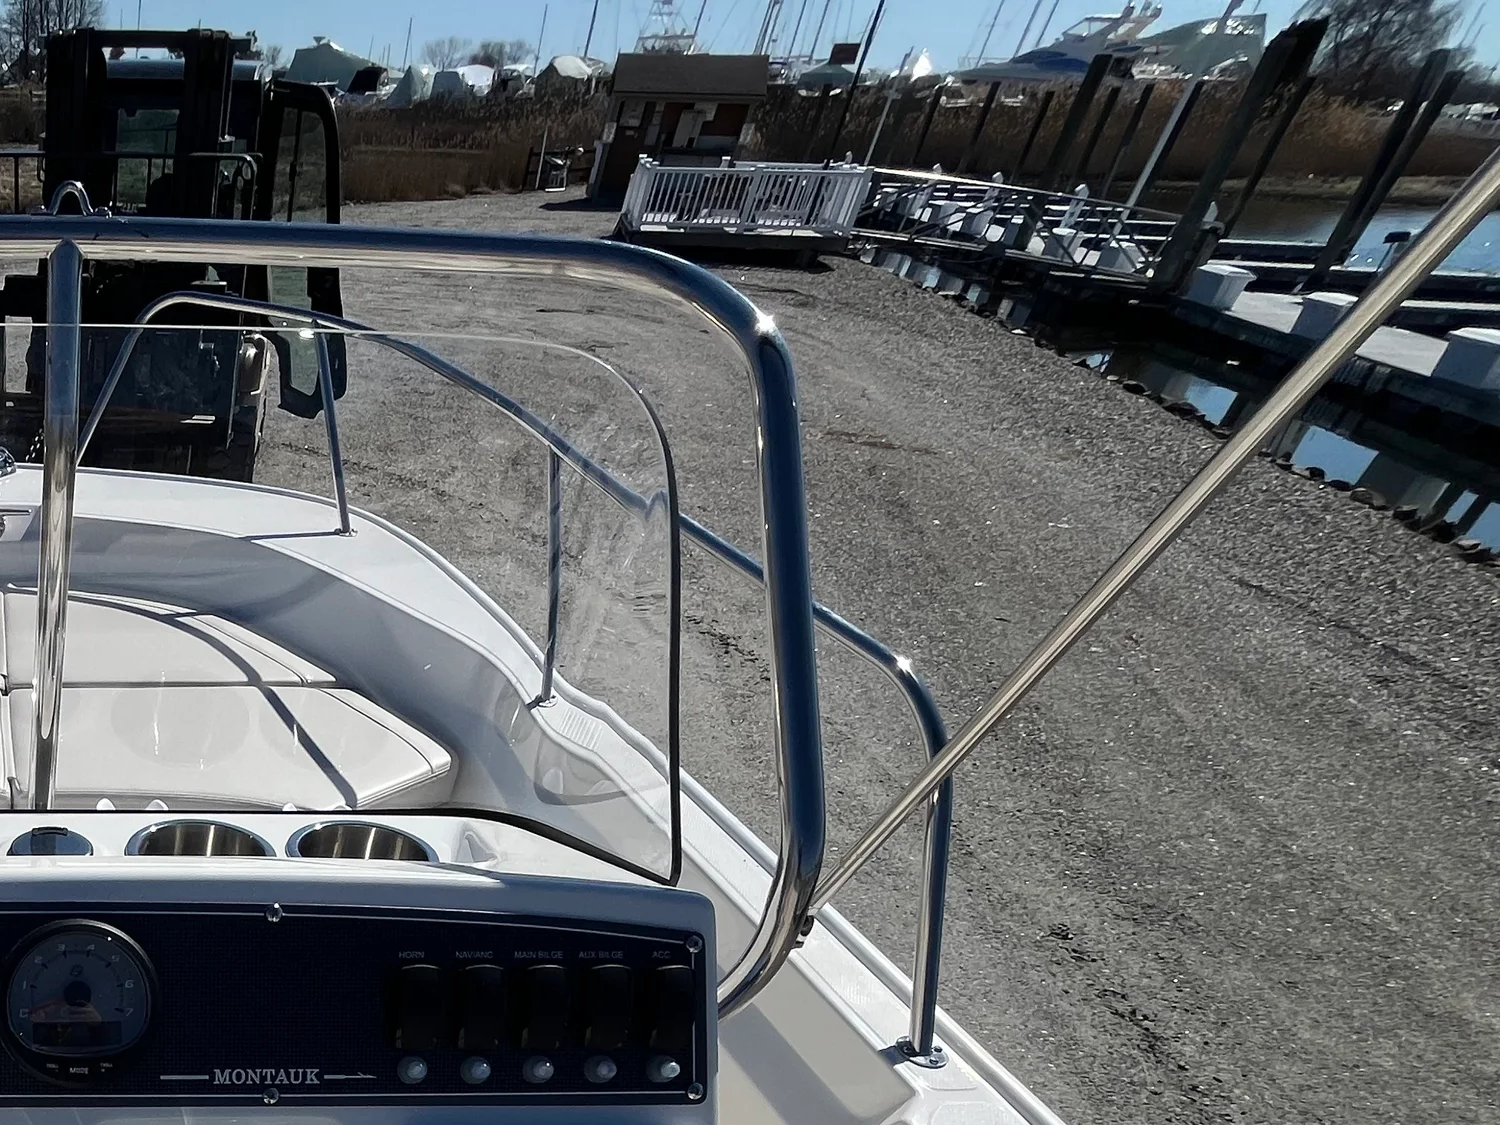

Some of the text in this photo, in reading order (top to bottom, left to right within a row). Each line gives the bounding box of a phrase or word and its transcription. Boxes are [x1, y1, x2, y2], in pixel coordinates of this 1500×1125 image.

[399, 951, 425, 959] HORN
[515, 951, 564, 959] MAIN BILGE
[578, 951, 624, 959] AUX BILGE
[652, 951, 671, 959] ACC
[213, 1069, 320, 1085] MONTAUK
